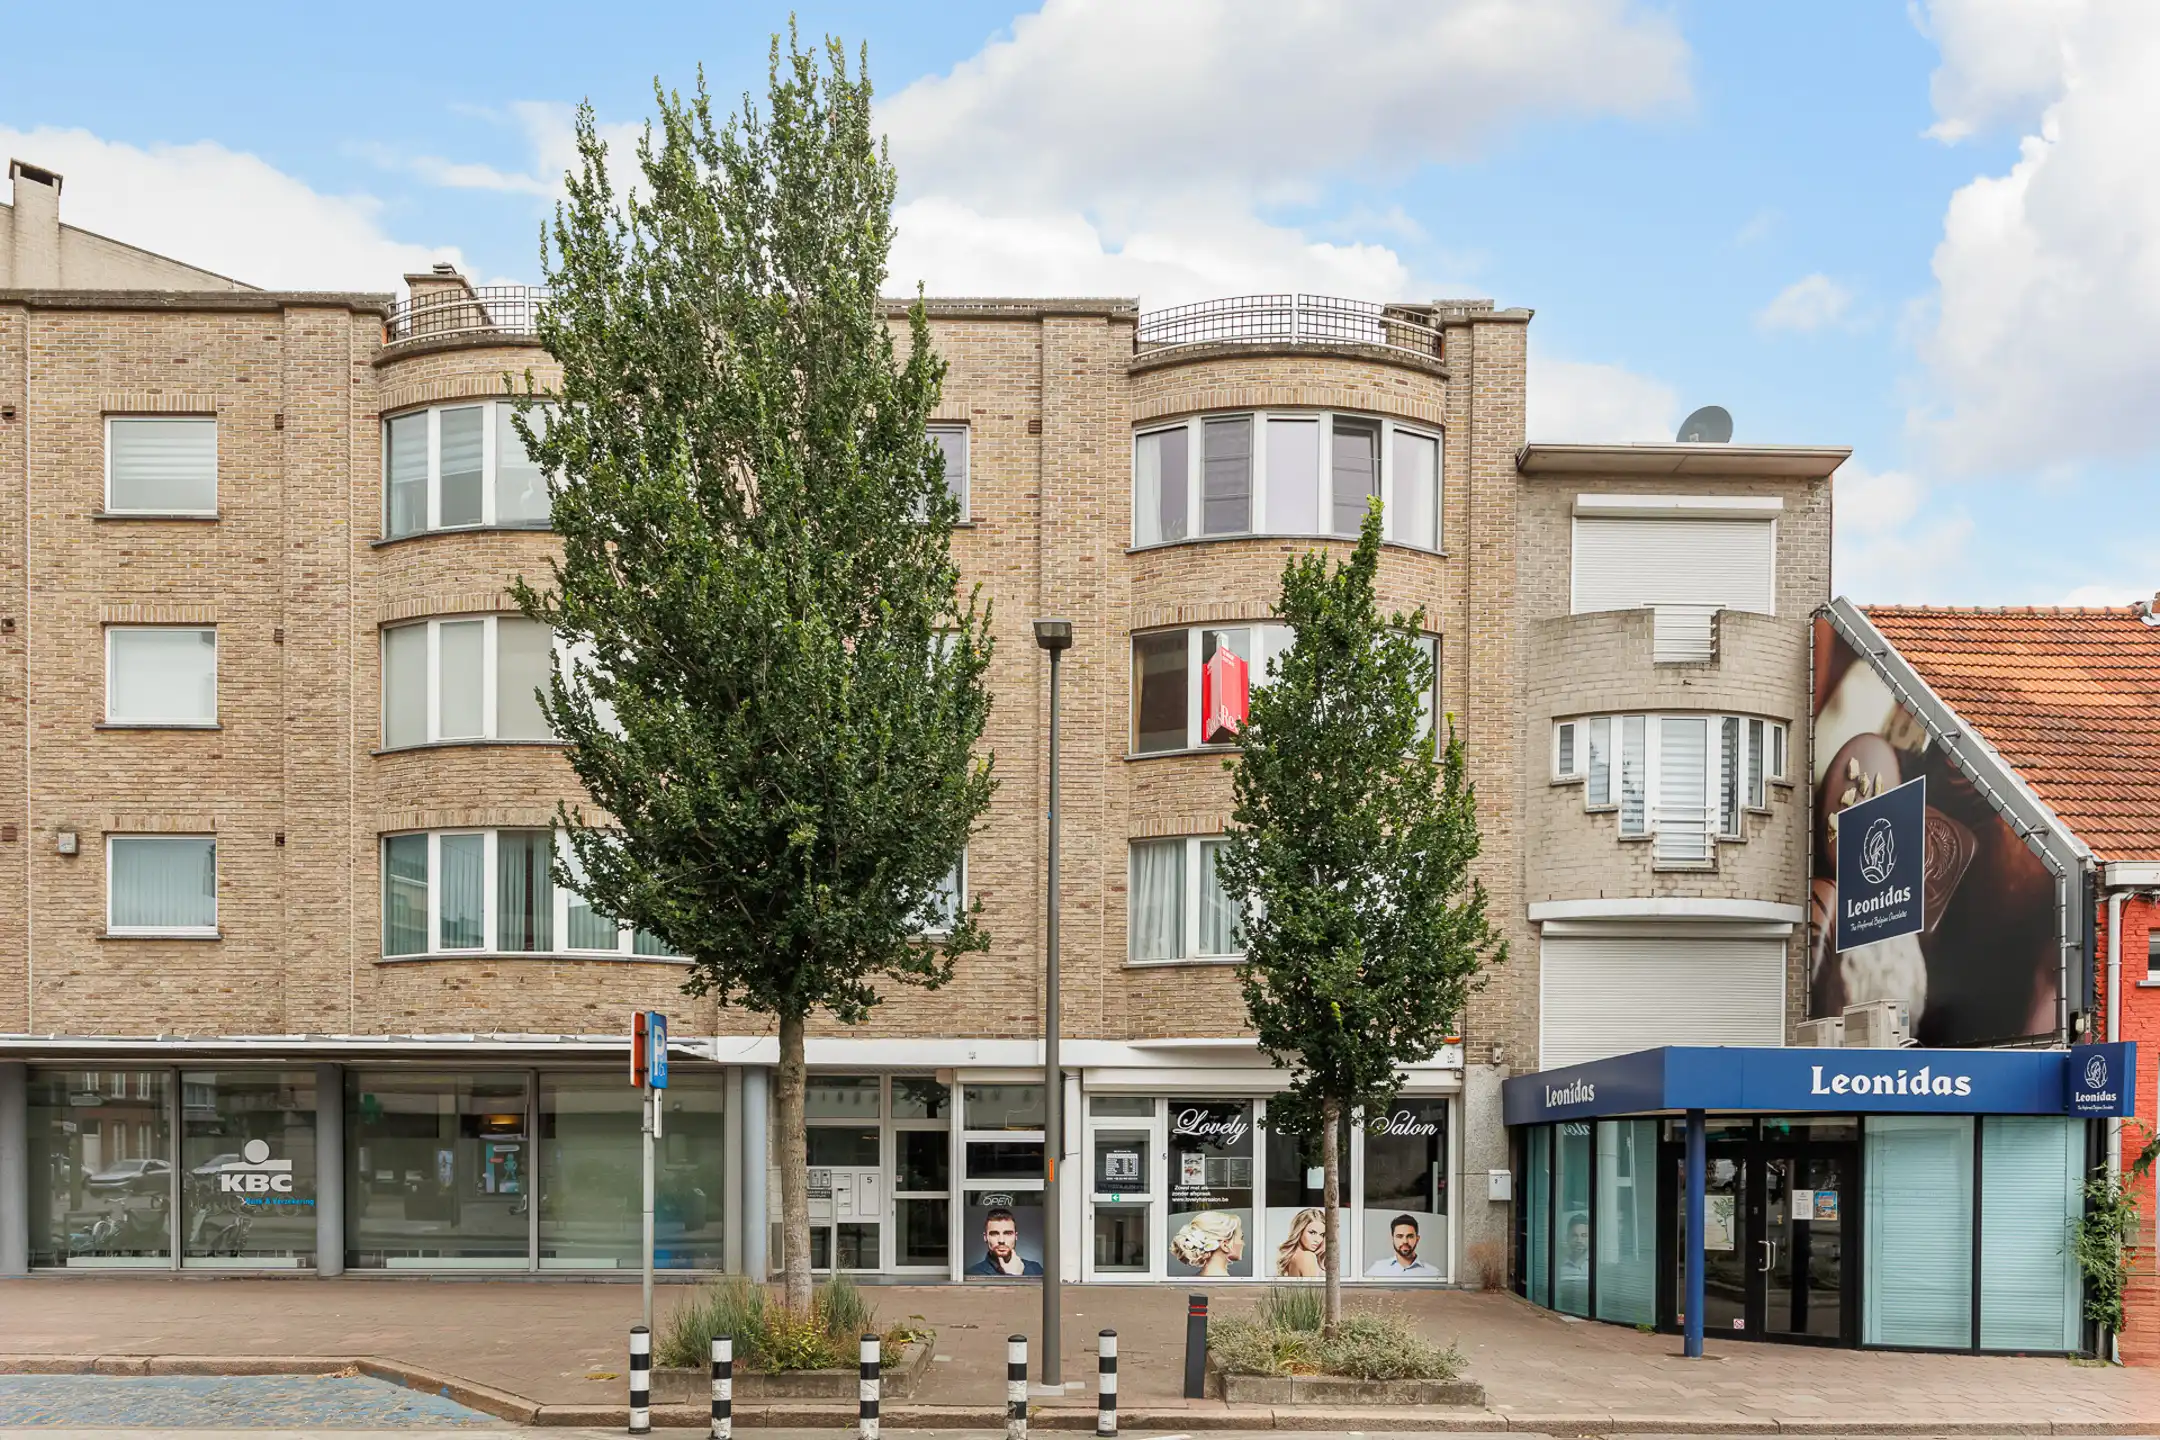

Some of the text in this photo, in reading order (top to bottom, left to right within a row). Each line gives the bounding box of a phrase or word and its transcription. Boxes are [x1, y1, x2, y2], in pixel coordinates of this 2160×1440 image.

[1847, 885, 1911, 918] Leonidas
[654, 1026, 665, 1076] P
[1545, 1077, 1595, 1107] Leonidas
[1811, 1065, 1972, 1096] Leonidas
[2075, 1090, 2117, 1102] Leonidas
[1173, 1108, 1249, 1145] Lovely
[1369, 1110, 1438, 1136] Salon
[221, 1174, 292, 1192] KBC
[867, 1176, 872, 1184] 5
[983, 1197, 1013, 1206] OPEN
